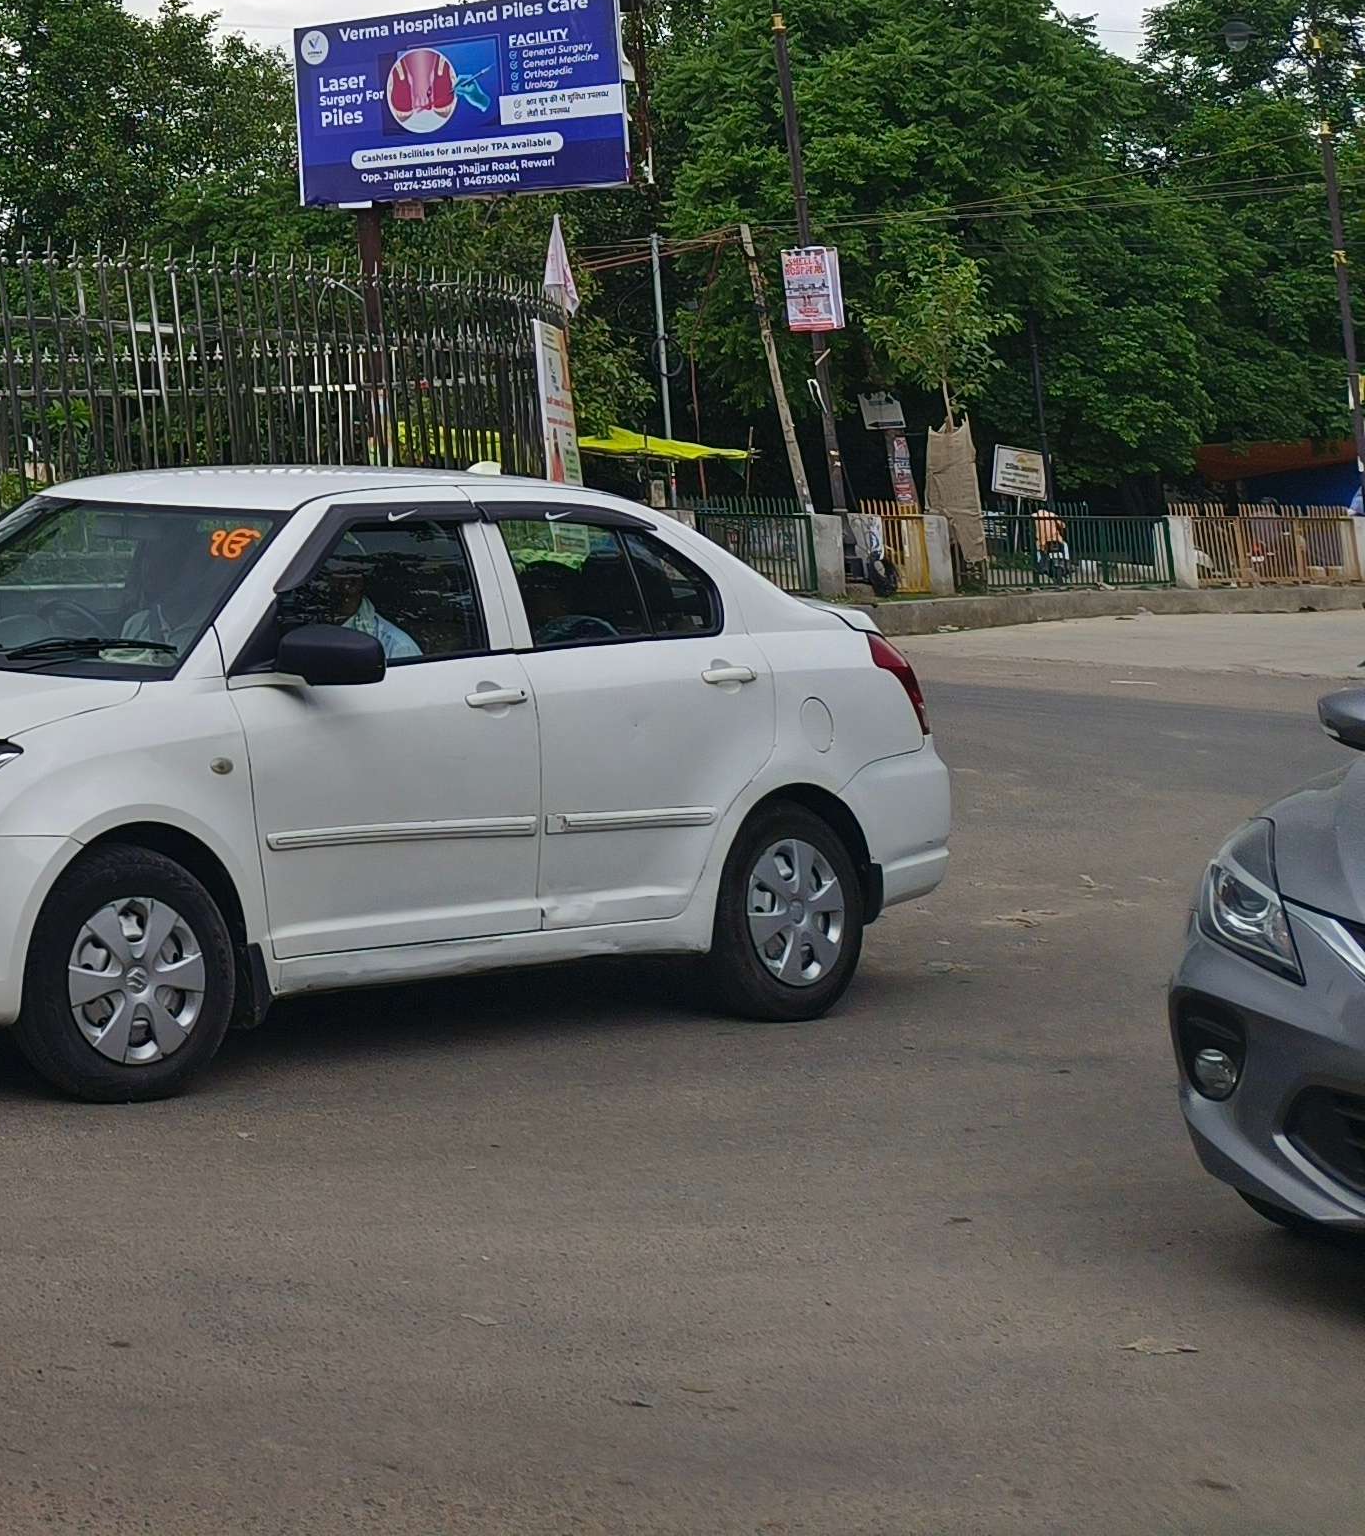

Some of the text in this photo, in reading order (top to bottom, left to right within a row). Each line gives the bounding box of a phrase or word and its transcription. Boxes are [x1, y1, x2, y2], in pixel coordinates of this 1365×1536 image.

[339, 25, 389, 41] Verma
[393, 12, 459, 35] Hospital
[463, 6, 497, 25] And
[502, 1, 543, 19] Piles
[508, 28, 569, 47] FACILITY
[522, 42, 592, 58] General Surgery
[523, 52, 599, 69] General Medicine
[524, 66, 573, 79] Orthopedic
[319, 75, 366, 92] Laser
[524, 79, 559, 90] Urology
[319, 90, 384, 106] Surgery For
[321, 108, 363, 127] Piles
[361, 137, 552, 163] Cashless facilities for all major TPA available
[361, 156, 555, 183] Opp. Jaildar Building, Jhajjar Road, Rewari
[464, 172, 520, 186] 9467590041
